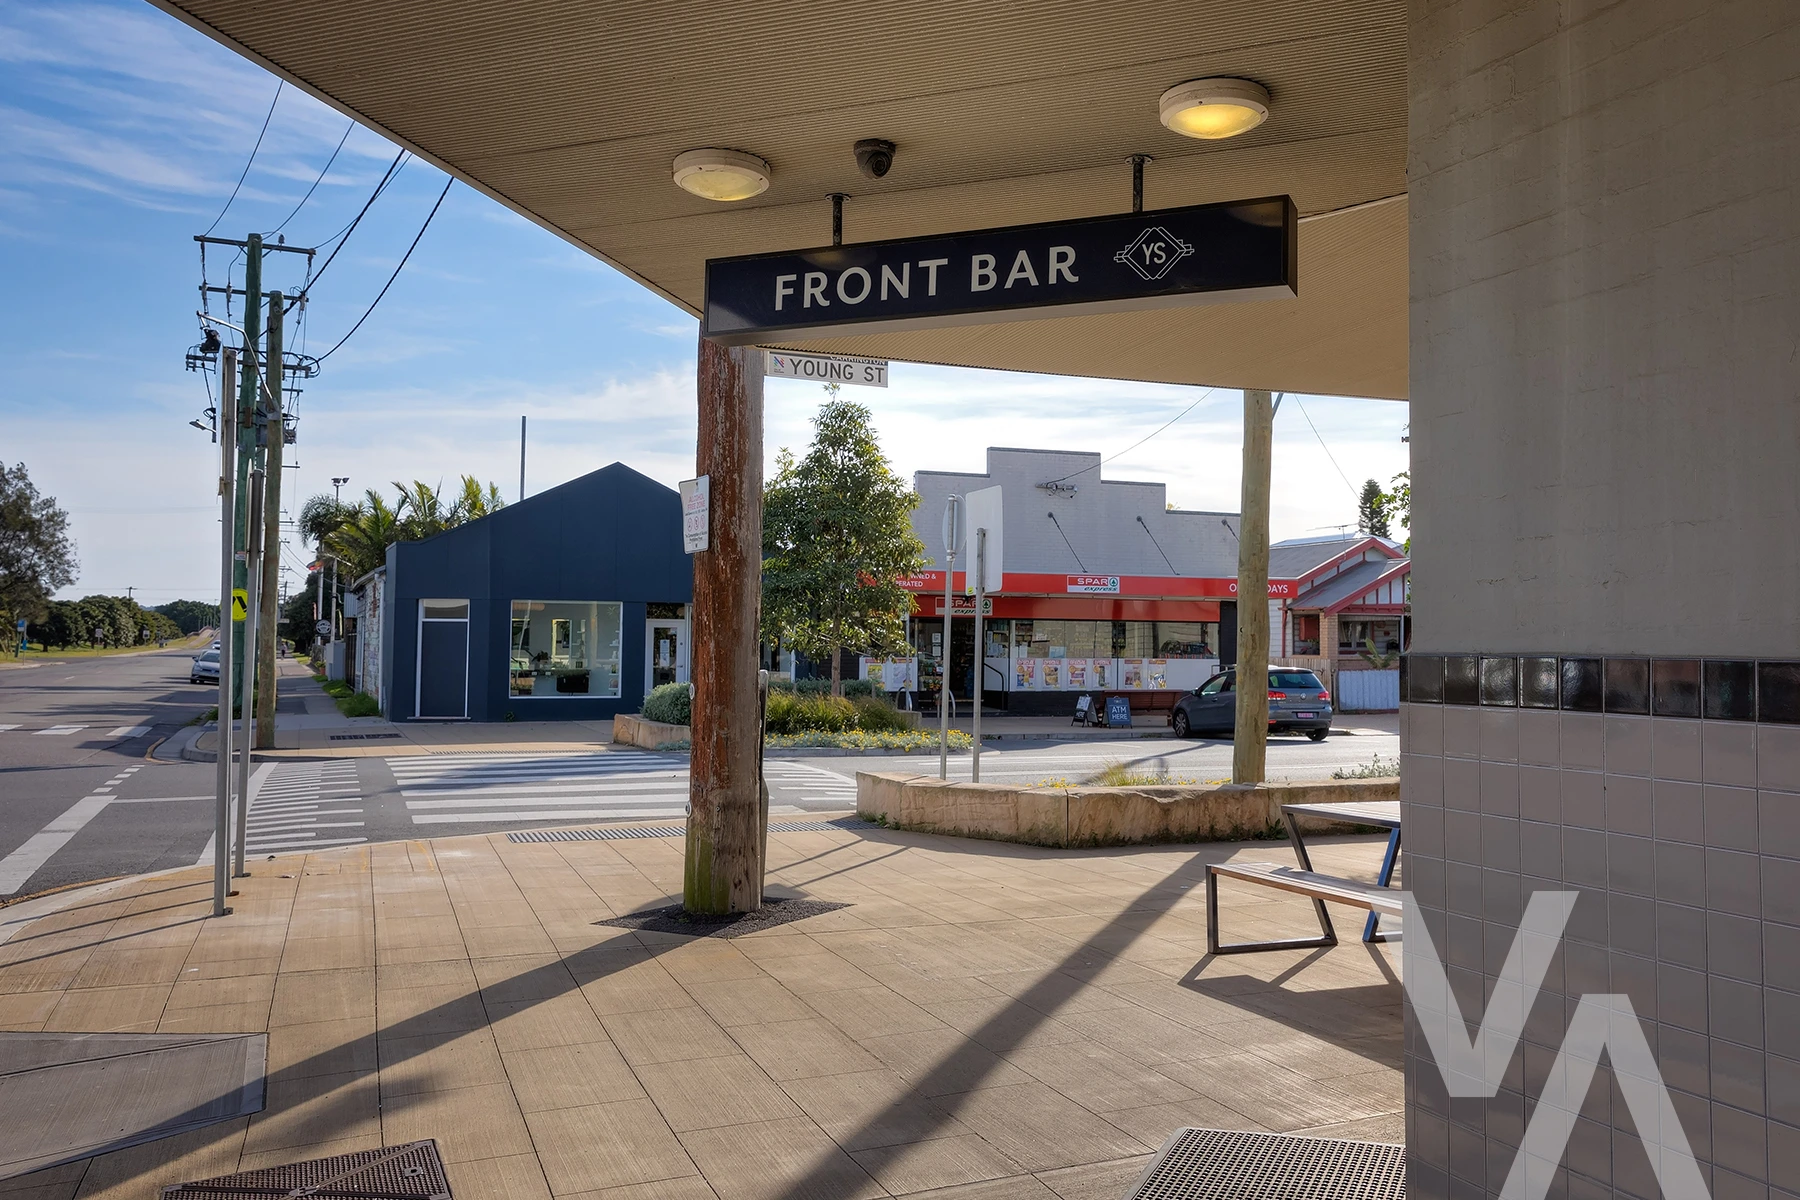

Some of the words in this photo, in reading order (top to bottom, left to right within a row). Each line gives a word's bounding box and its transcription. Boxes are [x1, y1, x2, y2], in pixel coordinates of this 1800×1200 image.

[1142, 241, 1167, 265] YS
[774, 257, 948, 311] FRONT
[970, 245, 1079, 293] BAR
[789, 358, 854, 380] YOUNG
[863, 366, 885, 383] ST
[1077, 577, 1108, 585] SPAR
